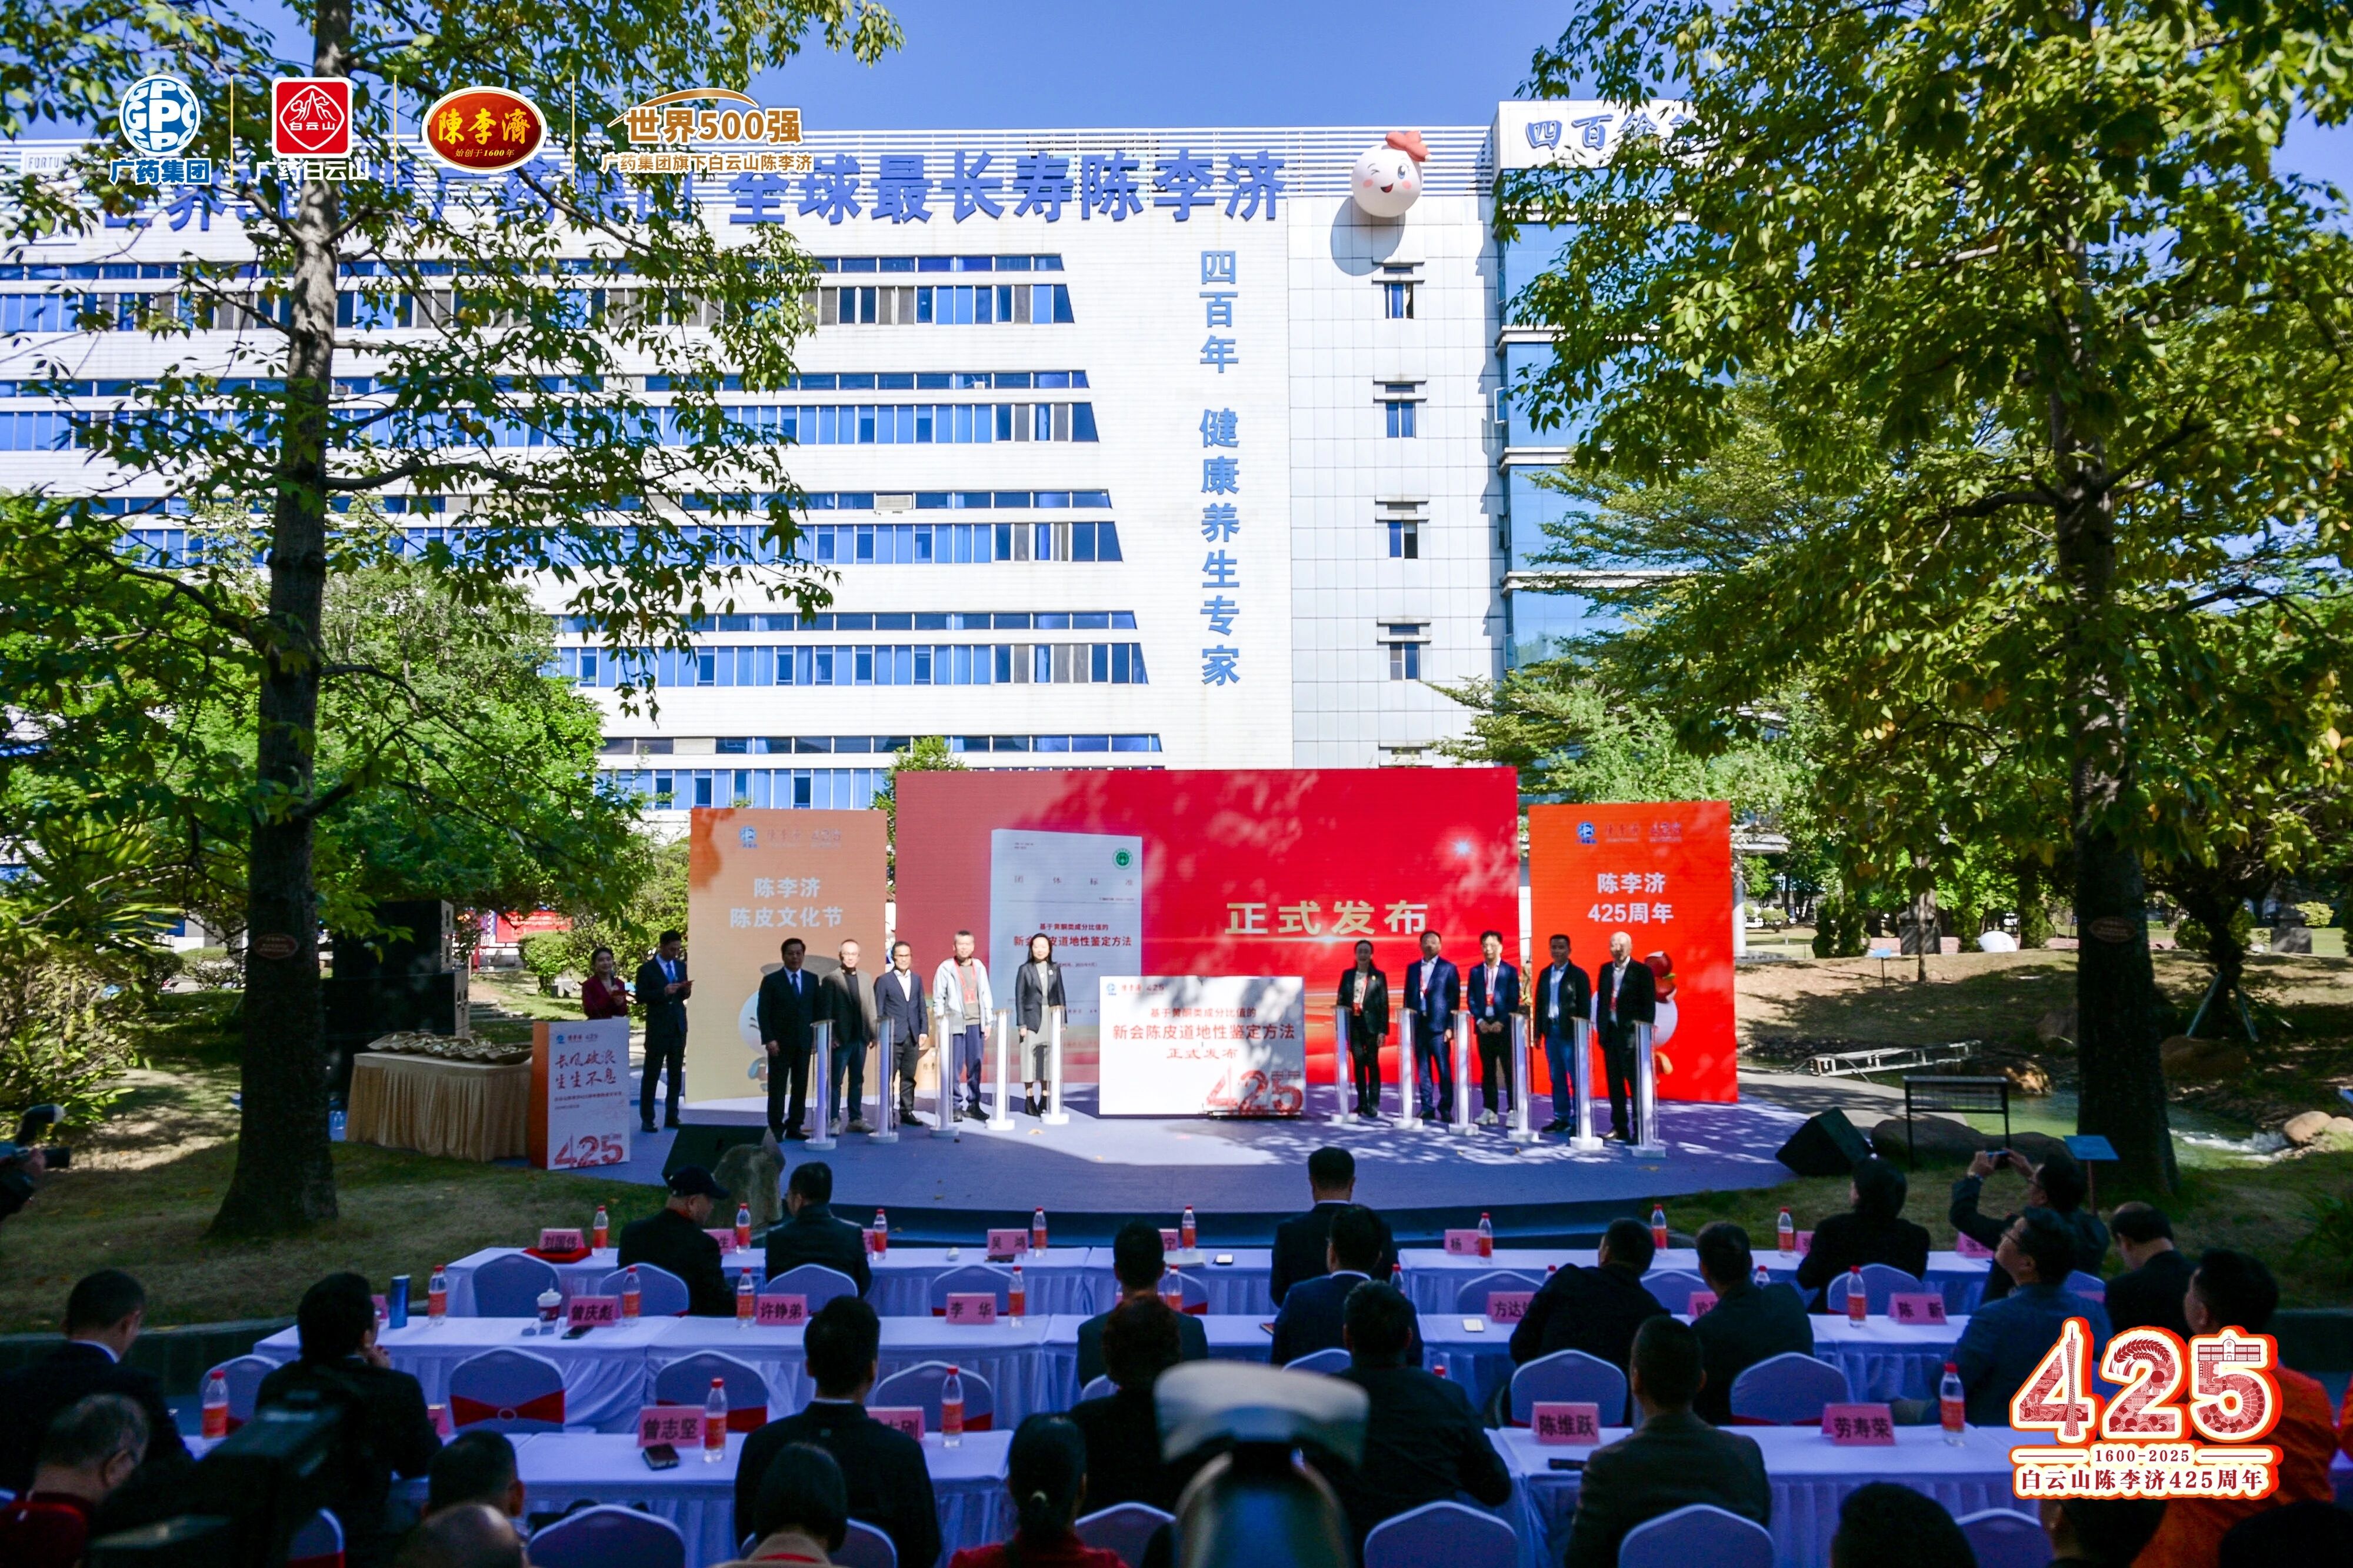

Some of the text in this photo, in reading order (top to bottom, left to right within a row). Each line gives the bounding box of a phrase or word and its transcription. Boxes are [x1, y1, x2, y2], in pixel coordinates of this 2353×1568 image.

[1525, 112, 1699, 151] 四百
[728, 149, 1286, 226] 全球最长寿陈李济
[1199, 250, 1240, 686] 四百年 健康养生专家
[754, 878, 821, 898] 陈李济
[1597, 872, 1666, 894] 陈李济
[729, 906, 843, 928] 陈皮文化节
[1225, 900, 1428, 935] 正式发布
[1587, 902, 1674, 924] 425周年
[1014, 935, 1132, 946] 新会皮道地性鉴定方法
[1112, 1025, 1295, 1040] 新会陈皮道地性鉴定方法
[1166, 1048, 1238, 1059] 正式发布
[555, 1067, 616, 1089] 生生不息
[1207, 1063, 1303, 1116] 425
[554, 1132, 624, 1167] 425
[643, 1417, 698, 1440] 曾志坚
[1537, 1414, 1595, 1438] 陈维跃
[1833, 1416, 1892, 1440] 劳寿荣
